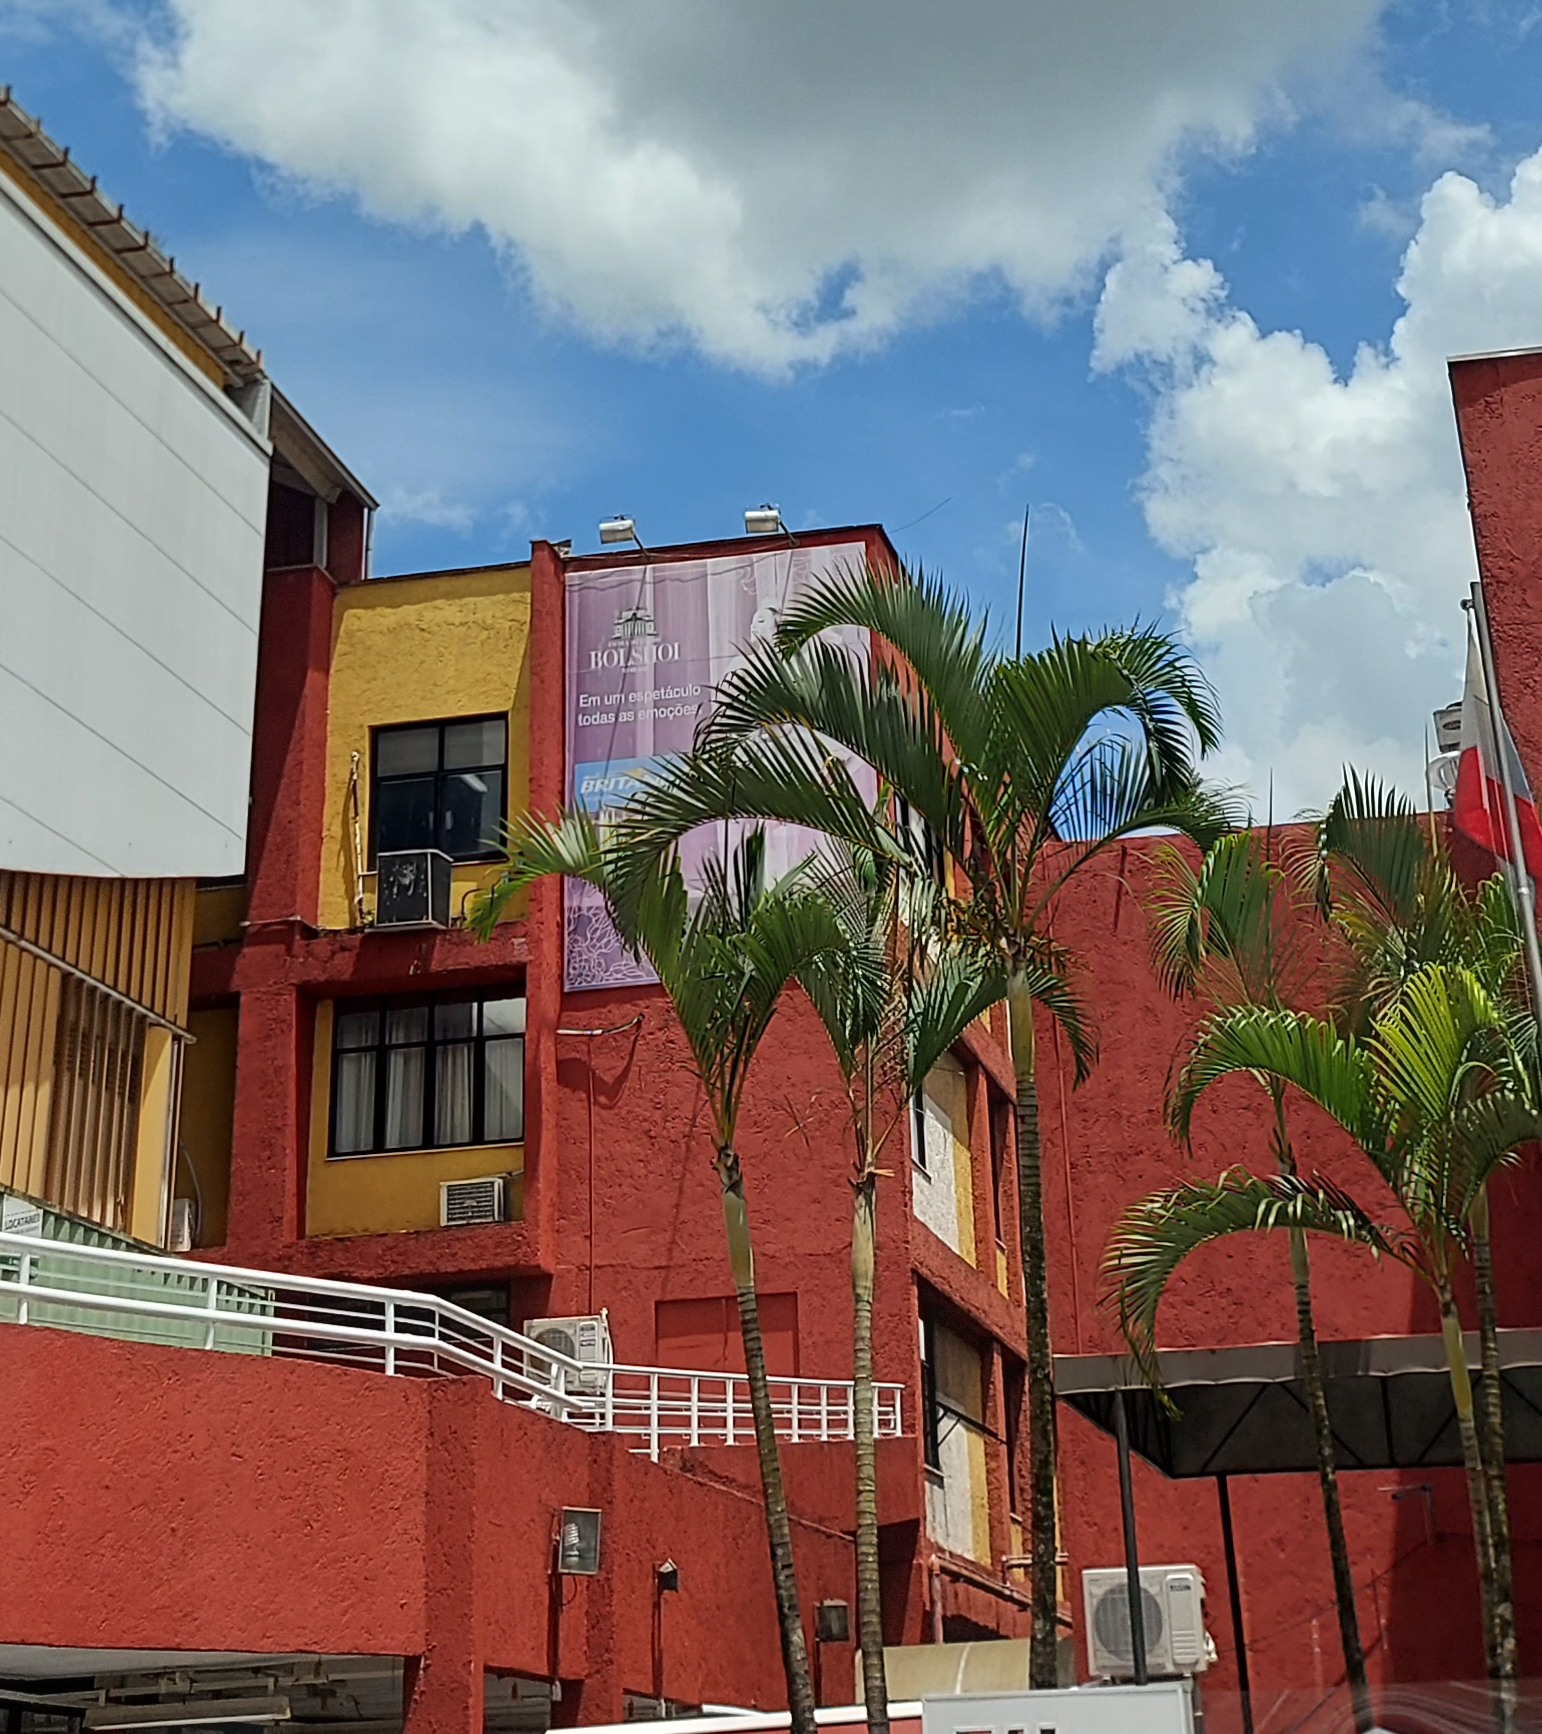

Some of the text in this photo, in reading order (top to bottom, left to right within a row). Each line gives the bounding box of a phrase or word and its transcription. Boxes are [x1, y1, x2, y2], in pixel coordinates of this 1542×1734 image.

[590, 642, 680, 670] BOLSHOI
[579, 683, 701, 708] Em um espetáculo
[578, 710, 616, 727] todas
[619, 710, 635, 722] as
